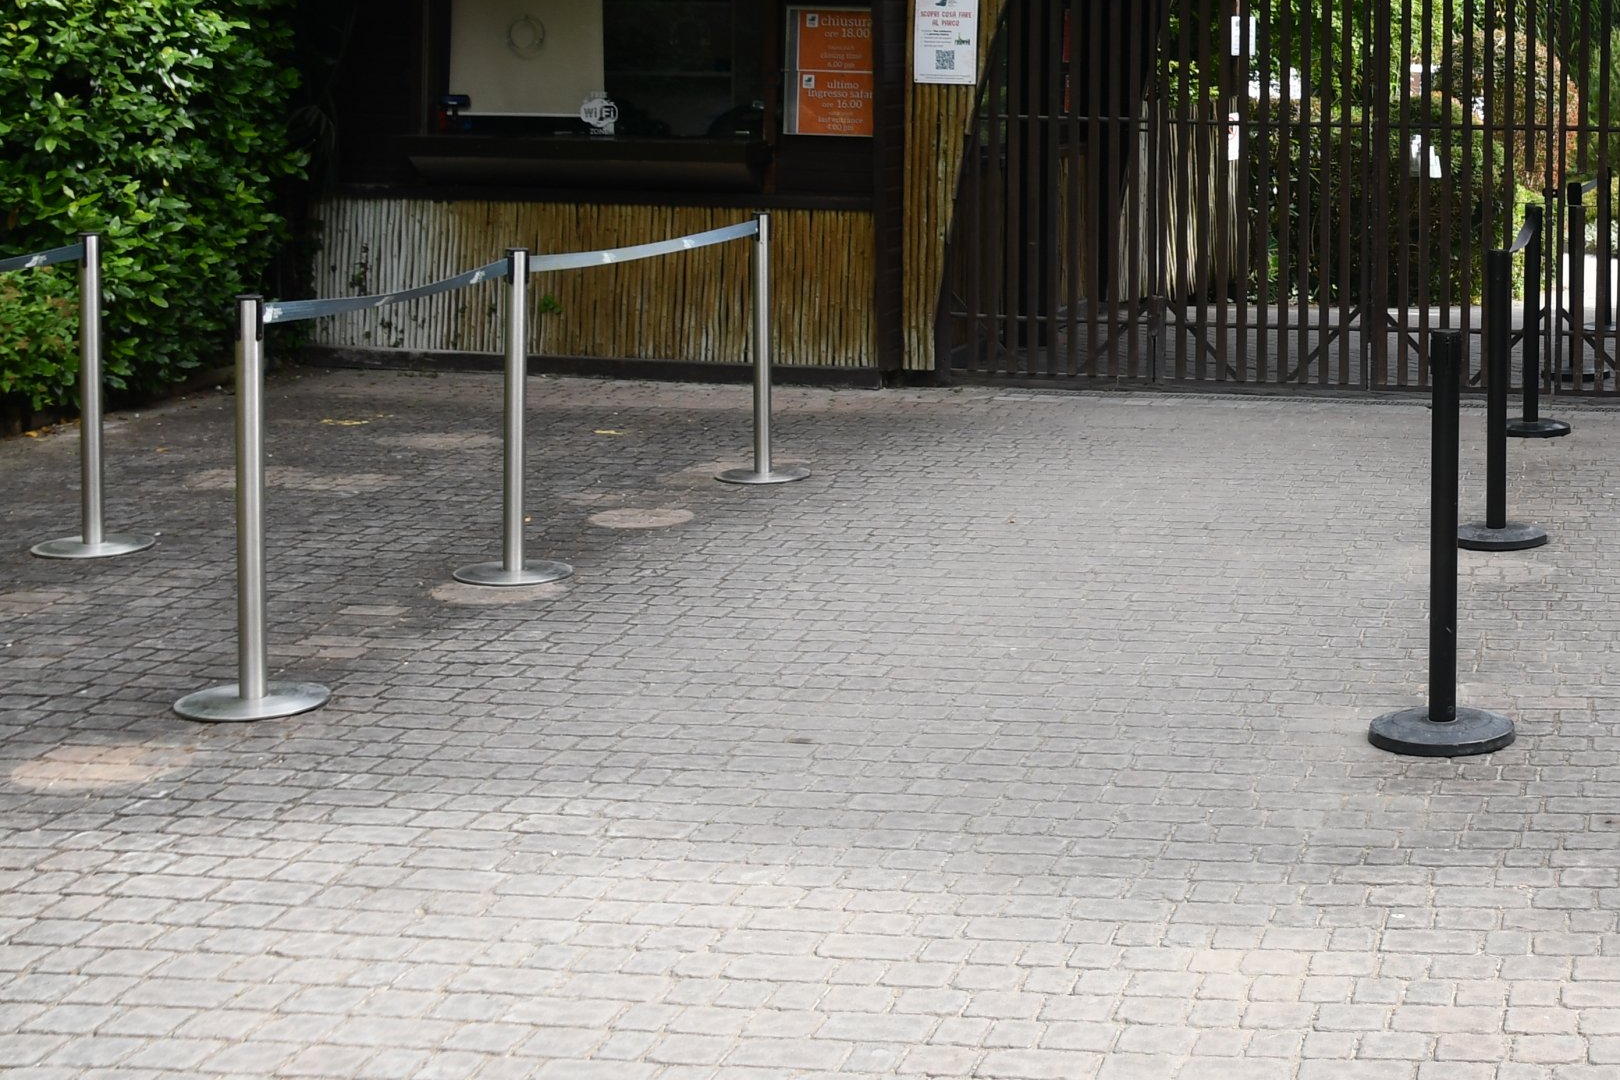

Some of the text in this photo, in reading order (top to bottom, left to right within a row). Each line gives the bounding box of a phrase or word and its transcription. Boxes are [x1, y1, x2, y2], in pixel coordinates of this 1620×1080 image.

[821, 15, 872, 27] chiusura
[825, 28, 871, 39] ore 18.00
[827, 79, 860, 90] ultimo
[808, 89, 848, 99] ingresso
[837, 99, 863, 109] 16.00
